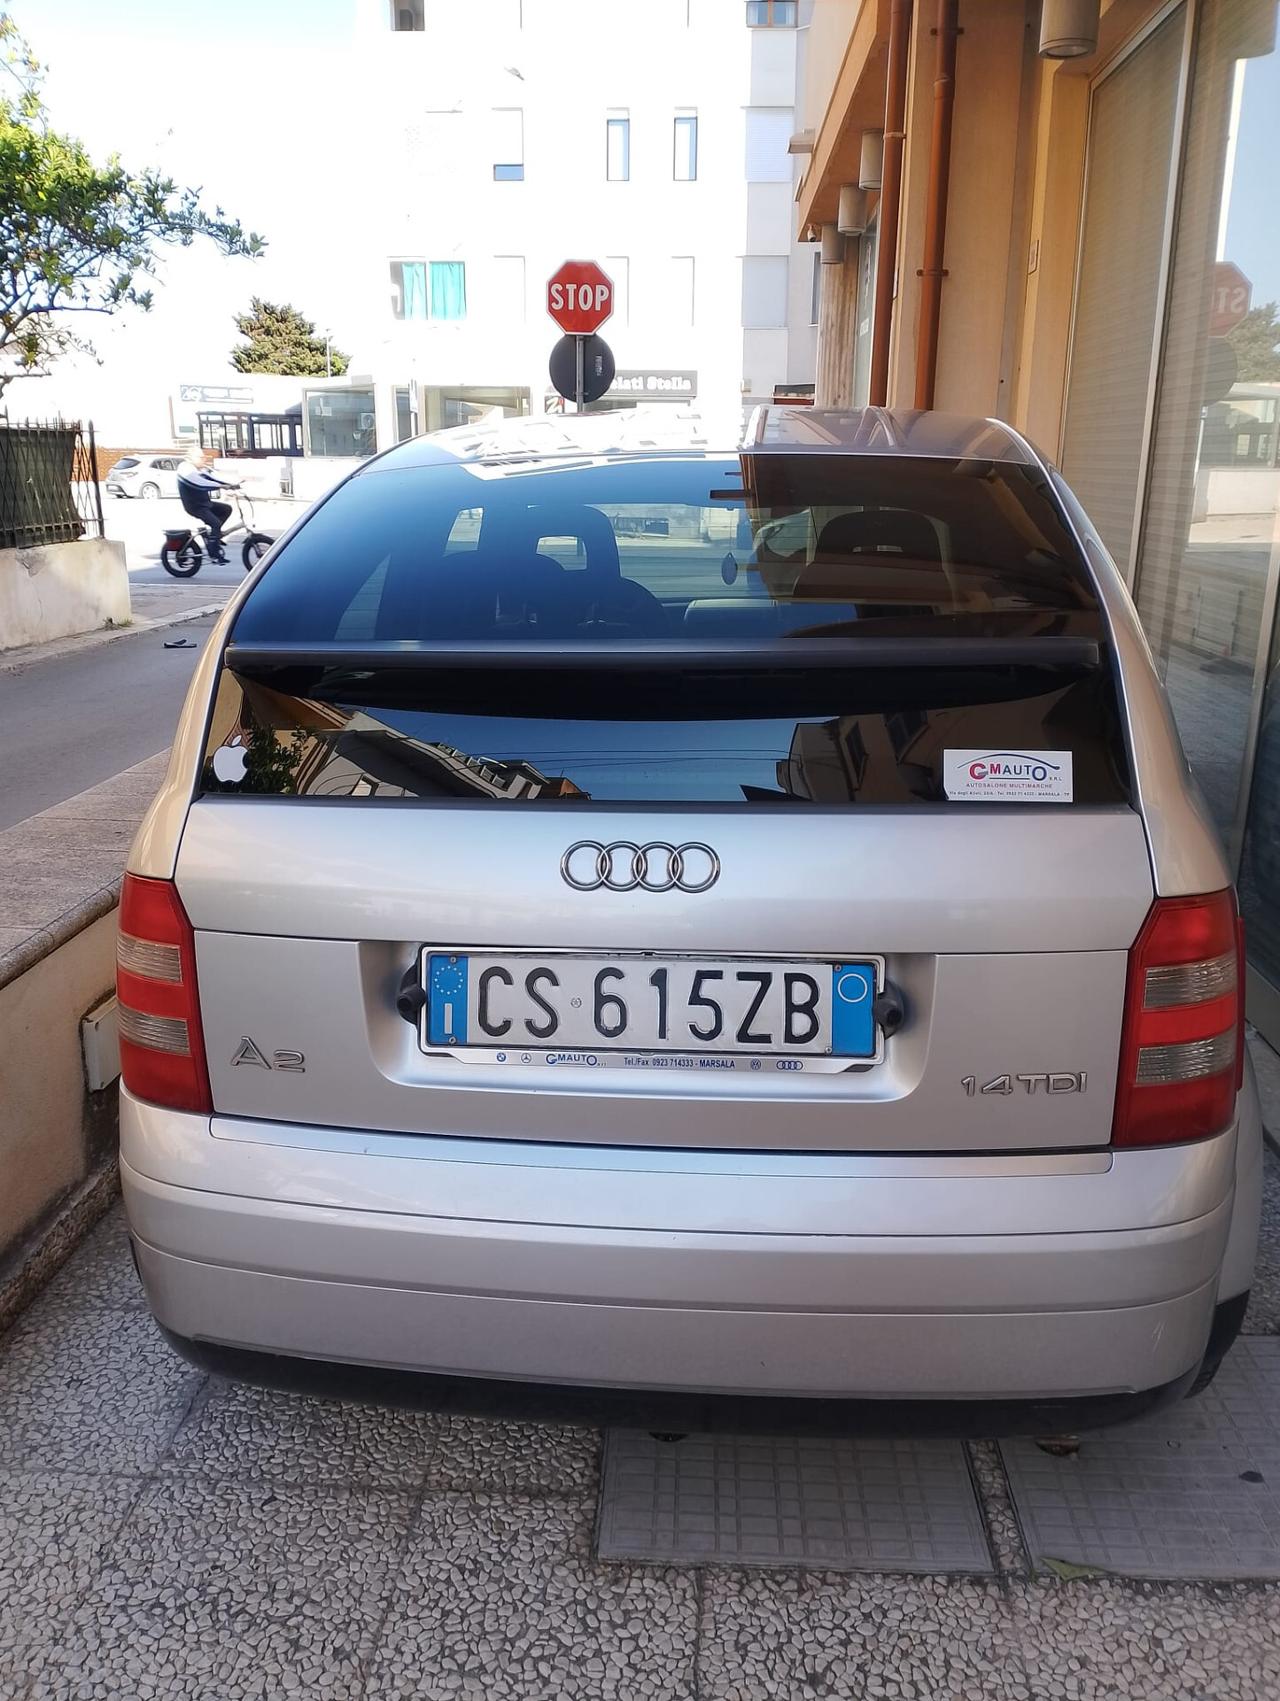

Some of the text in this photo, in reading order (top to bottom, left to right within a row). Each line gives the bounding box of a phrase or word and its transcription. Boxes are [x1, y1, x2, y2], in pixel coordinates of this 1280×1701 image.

[550, 283, 610, 311] STOP
[610, 375, 692, 391] elati Stella
[478, 965, 821, 1045] CS 615ZB
[231, 1035, 306, 1073] A2
[652, 1057, 668, 1067] 0923
[669, 1058, 694, 1068] 714333
[699, 1058, 735, 1069] MARSALA
